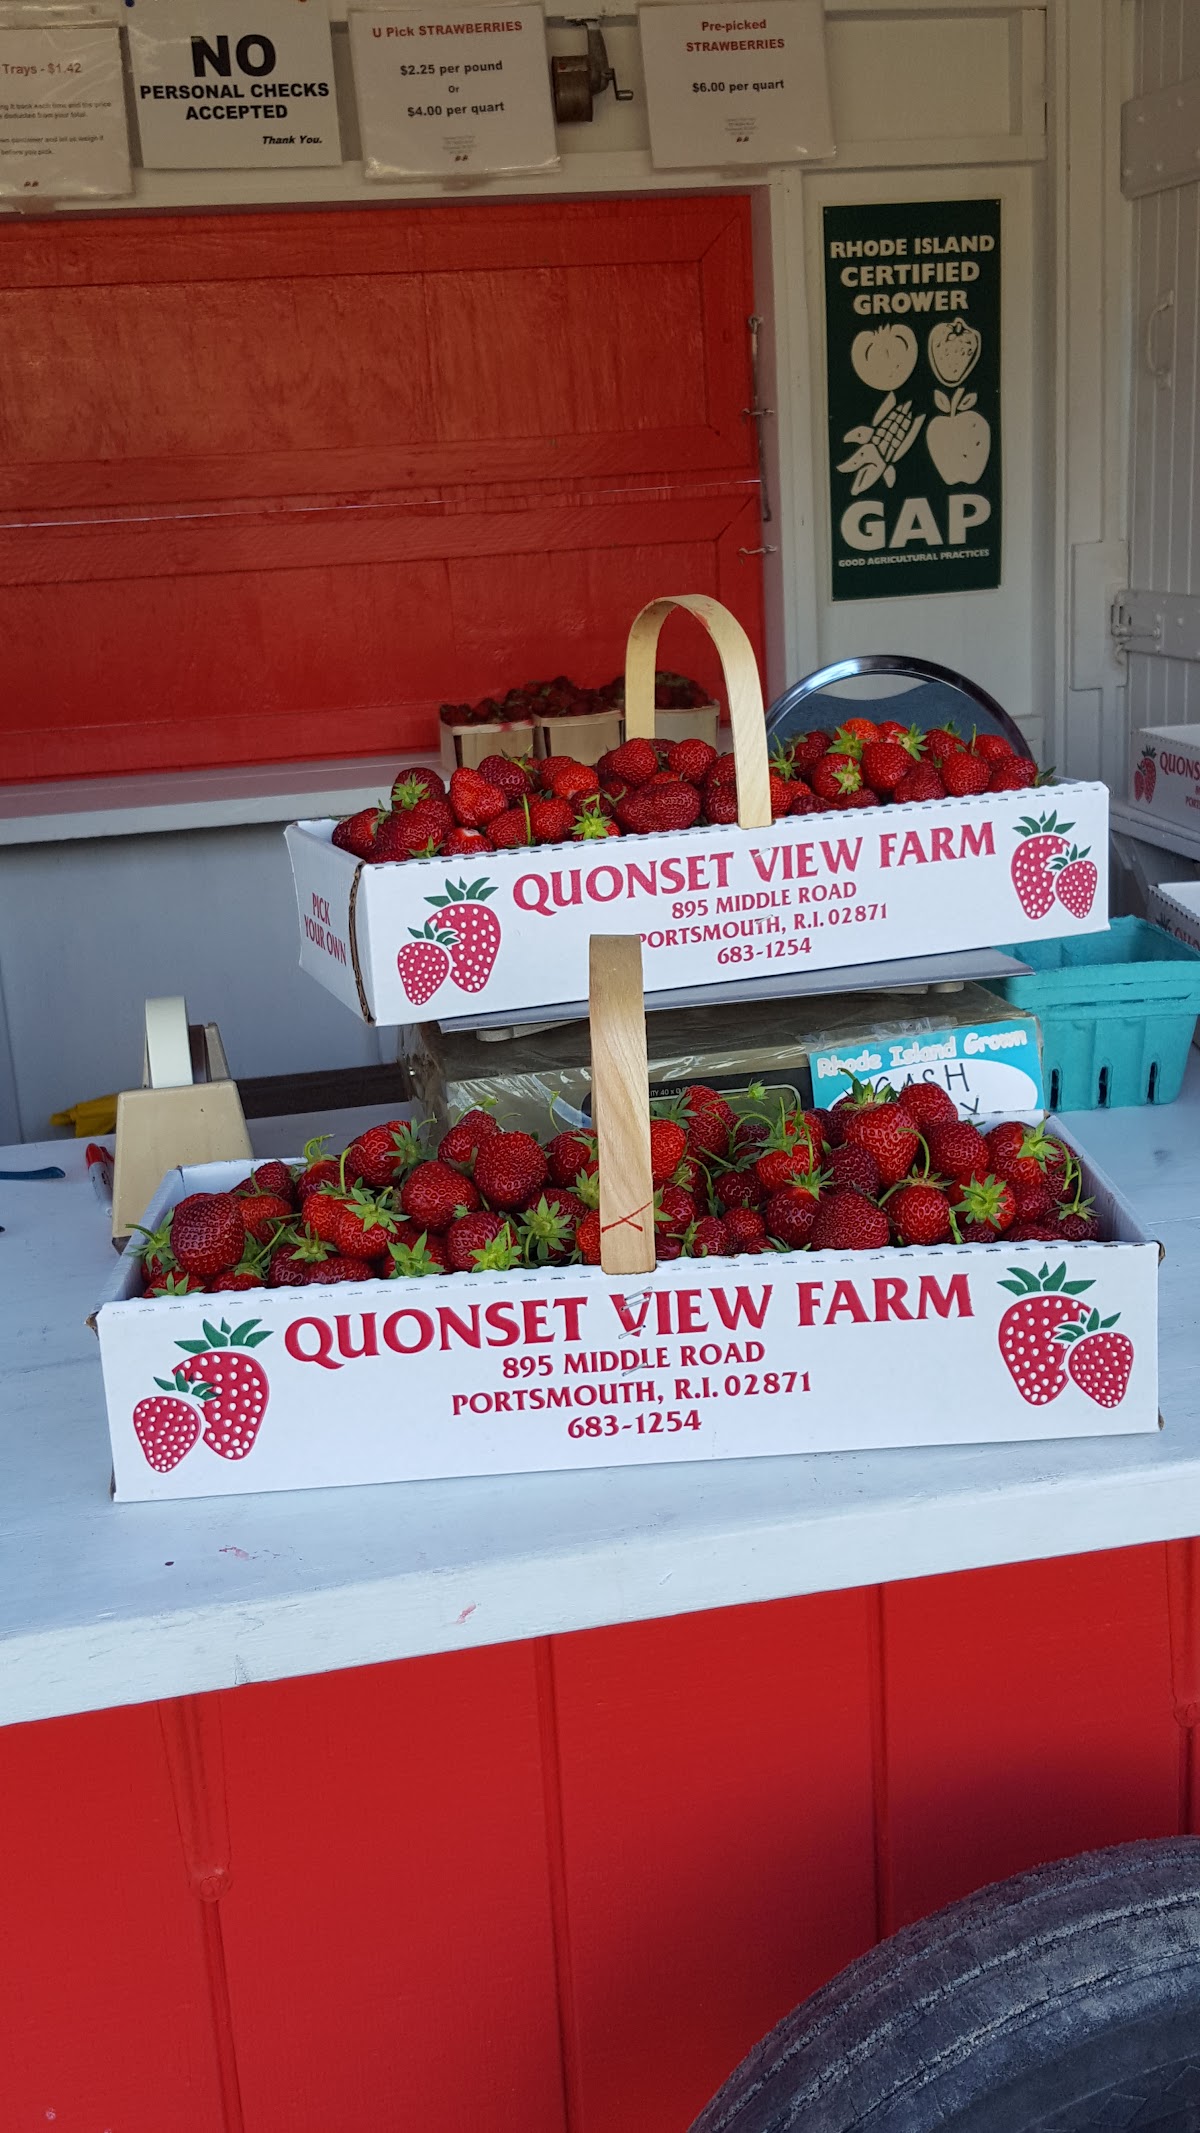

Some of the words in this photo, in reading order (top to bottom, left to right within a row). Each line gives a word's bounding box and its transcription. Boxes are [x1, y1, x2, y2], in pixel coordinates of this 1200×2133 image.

[372, 27, 382, 39] U
[386, 25, 415, 38] Pick
[418, 20, 523, 37] STRAWBERRIES
[701, 18, 769, 33] Pre-picked
[190, 33, 277, 78] NO
[684, 38, 787, 53] STRAWBERRIES
[1, 63, 38, 76] Trays
[47, 62, 82, 75] $1.42
[400, 64, 436, 77] $2.25
[439, 64, 461, 78] per
[464, 60, 504, 76] pound
[139, 83, 245, 100] PERSONAL
[250, 82, 330, 98] CHECKS
[447, 84, 460, 94] Or
[691, 81, 727, 95] $6.00
[728, 82, 750, 95] per
[752, 78, 786, 93] quart
[185, 104, 288, 121] ACCEPTED
[406, 105, 443, 118] $4.00
[445, 106, 468, 118] per
[471, 101, 506, 116] quart
[262, 135, 296, 146] Thank
[299, 134, 323, 145] You.
[829, 238, 908, 260] RHODE
[913, 234, 996, 256] ISLAND
[840, 261, 981, 289] CERTIFIED
[852, 290, 970, 315] GROWER
[839, 492, 992, 552] GAP
[838, 557, 866, 568] GOOD
[867, 552, 939, 567] AGRICULTURAL
[940, 548, 990, 561] PRACTICES
[512, 852, 734, 917] QUONSET
[749, 837, 863, 883] VIEW
[879, 821, 996, 869] FARM
[311, 891, 332, 928] PICK
[671, 899, 709, 919] 895
[716, 889, 792, 913] MIDDLE
[797, 881, 858, 905] ROAD
[303, 913, 326, 951] YOUR
[326, 930, 347, 967] OWN
[717, 937, 812, 965] 683-1254
[816, 1049, 883, 1079] Rhode
[888, 1035, 957, 1067] Island
[963, 1029, 1028, 1056] Grown
[283, 1296, 589, 1371] QUONSET
[609, 1284, 773, 1340] VIEW
[797, 1273, 974, 1327] FARM
[502, 1355, 554, 1380] 895
[564, 1347, 670, 1375] MIDDLE
[680, 1341, 765, 1367] ROAD
[452, 1381, 664, 1416] PORTSMOUTH,
[567, 1409, 702, 1439] 683-1254
